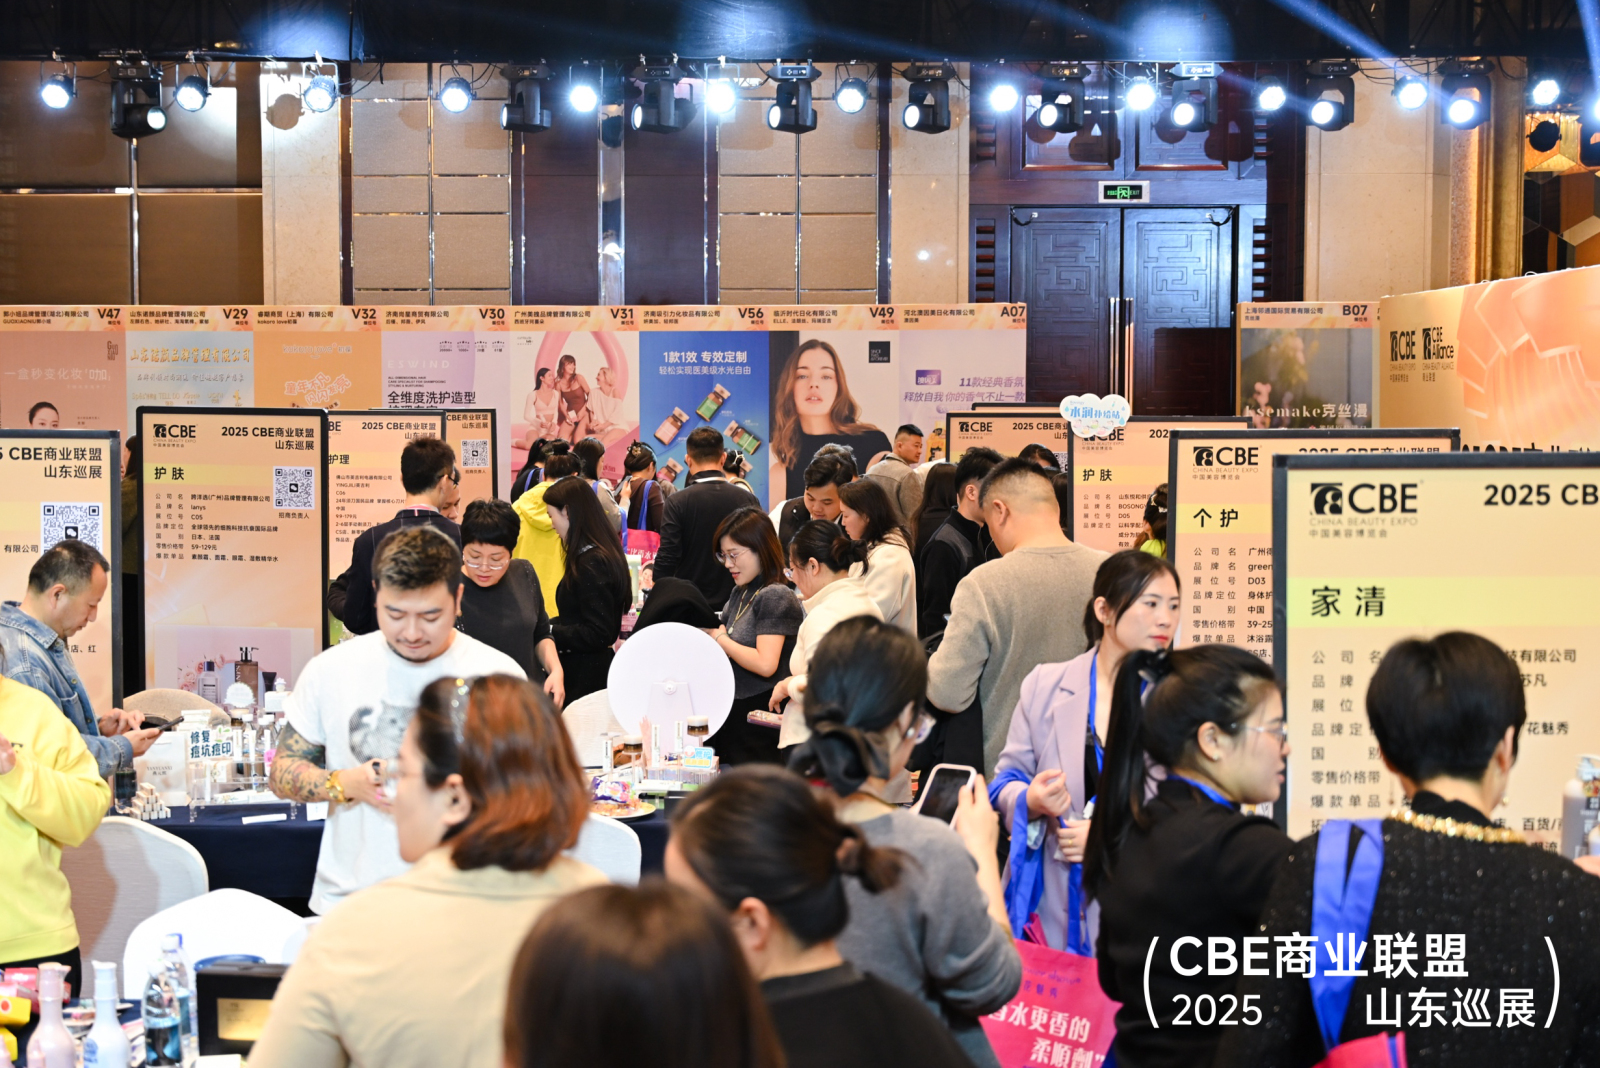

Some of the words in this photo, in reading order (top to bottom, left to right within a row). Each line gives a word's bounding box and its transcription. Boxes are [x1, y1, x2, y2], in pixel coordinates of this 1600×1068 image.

[97, 308, 121, 319] V47
[223, 308, 249, 319] V29
[351, 308, 377, 319] V32
[479, 308, 505, 319] V30
[611, 308, 634, 319] V31
[738, 308, 764, 319] V56
[869, 306, 895, 318] V49
[1000, 306, 1026, 318] A07
[1342, 304, 1368, 316] B07
[1432, 326, 1443, 343] CBE
[1399, 330, 1416, 360] CBE
[663, 350, 698, 364] 1款1效
[701, 350, 748, 364] 专效定制
[1432, 343, 1454, 360] Alliance
[387, 360, 450, 369] ESWIND
[658, 365, 752, 376] 轻松实现医美级水光自由
[284, 372, 331, 395] 童年不凡
[959, 376, 1025, 388] 11款经典香氛
[305, 374, 351, 406] 闪闪发亮
[387, 390, 477, 404] 全维度洗护造型
[903, 391, 944, 402] 释放自我
[945, 391, 1026, 402] 你的香气不止一款
[446, 414, 489, 422] CBE商业联盟
[1070, 406, 1121, 420] 水润补给站
[168, 424, 197, 439] CBE
[362, 421, 384, 430] 2025
[386, 422, 437, 431] CBE商业联盟
[461, 422, 489, 430] 山东巡展
[970, 421, 993, 433] CBE
[1012, 422, 1034, 431] 2025
[221, 426, 249, 437] 2025
[252, 427, 315, 439] CBE商业联盟
[275, 440, 315, 451] 山东巡展
[9, 446, 102, 461] CBE商业联盟
[1216, 446, 1259, 466] CBE
[44, 464, 103, 479] 山东巡展
[154, 466, 185, 481] 护肤
[1083, 468, 1112, 482] 护肤
[1348, 483, 1418, 515] CBE
[1483, 483, 1551, 507] 2025
[278, 512, 310, 520] 招商负责人
[1193, 508, 1239, 528] 个护
[1309, 517, 1344, 527] CHINA
[1347, 517, 1387, 527] BEAUTY
[1390, 517, 1419, 527] EXPO
[1309, 528, 1388, 538] 中国美容博览会
[4, 545, 39, 553] 有限公司
[1193, 547, 1236, 556] 公司名
[1193, 562, 1236, 571] 品牌名
[1193, 576, 1236, 585] 展位号
[1247, 577, 1266, 585] D03
[1193, 591, 1236, 600] 品牌定位
[1310, 585, 1386, 617] 家清
[1193, 605, 1236, 614] 国别
[1247, 605, 1265, 614] 中国
[1192, 619, 1236, 629] 零售价格带
[1247, 620, 1273, 629] 39-25
[1192, 634, 1235, 643] 爆款单品
[1311, 722, 1374, 737] 品牌定
[1525, 722, 1569, 736] 花魅秀
[190, 729, 211, 744] 修复
[190, 740, 232, 758] 痘坑痘印
[1311, 770, 1381, 785] 零售价格带
[1310, 794, 1381, 808] 爆款单品
